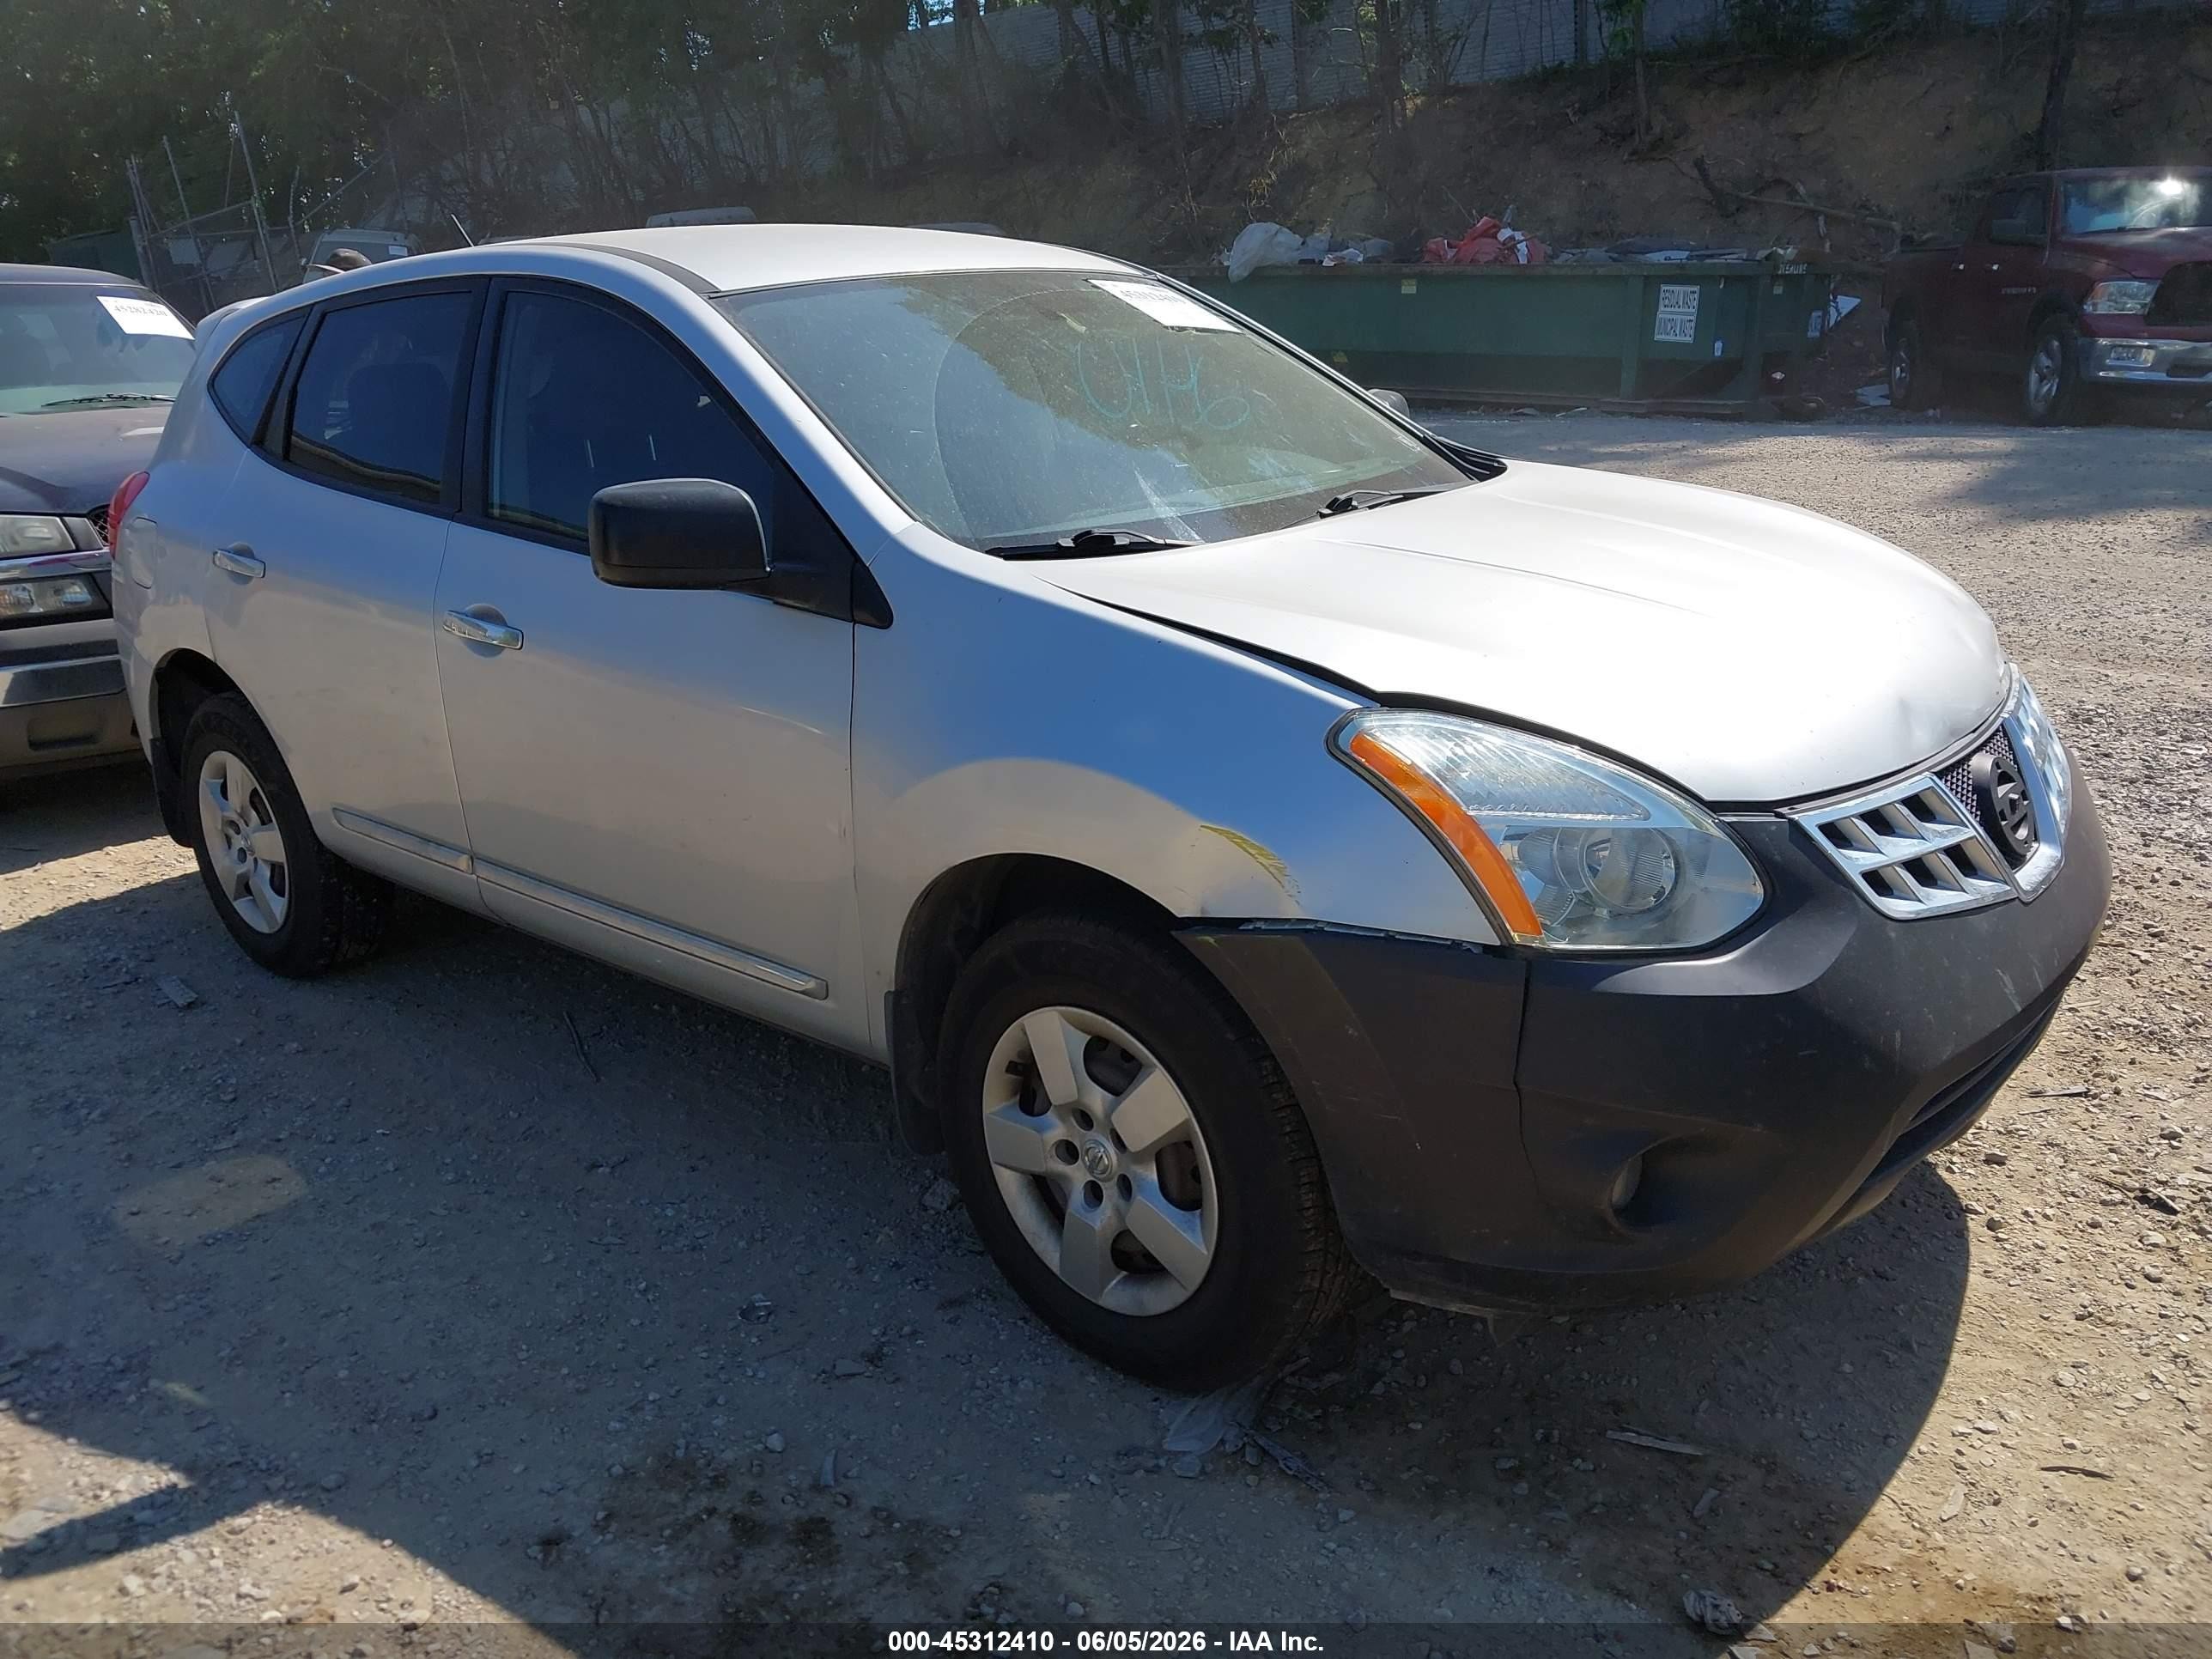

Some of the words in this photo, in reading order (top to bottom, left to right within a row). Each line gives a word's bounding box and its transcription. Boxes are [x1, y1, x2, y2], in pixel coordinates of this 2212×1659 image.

[1662, 289, 1681, 308] RESIDUAL
[1681, 289, 1698, 310] WASTE
[1657, 317, 1678, 337] MUNICIPAL
[1678, 319, 1695, 338] WASTE
